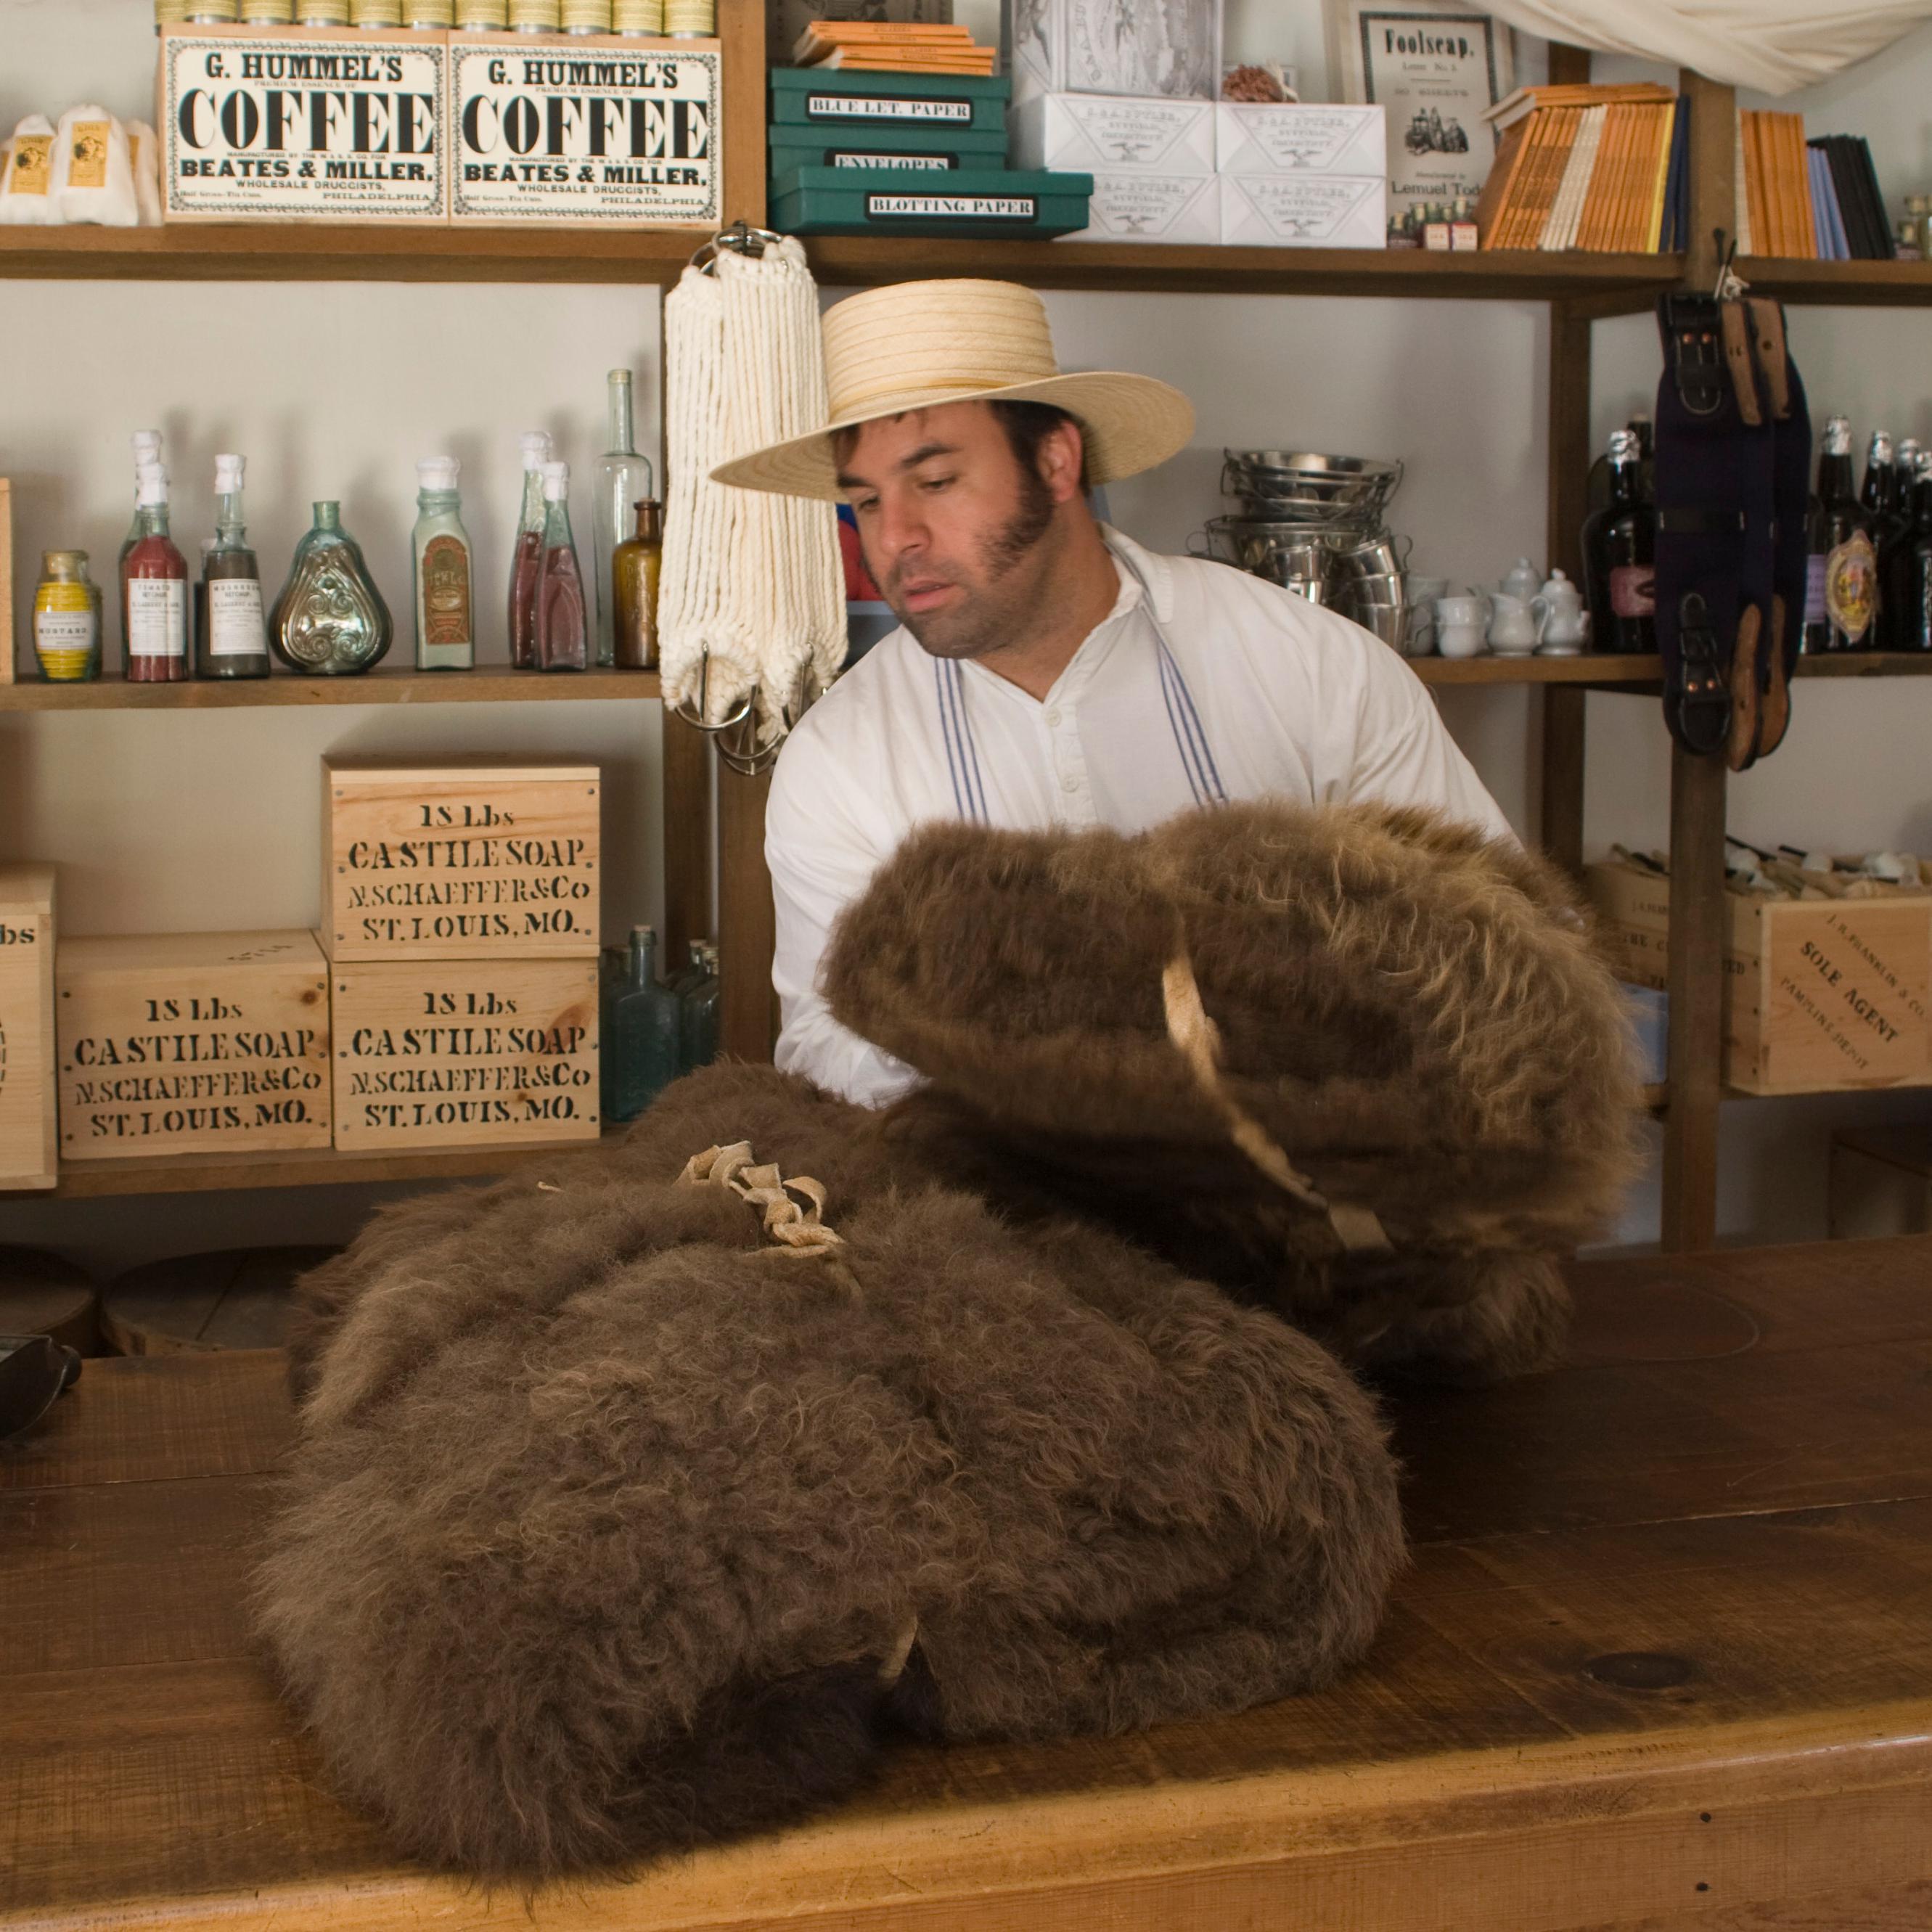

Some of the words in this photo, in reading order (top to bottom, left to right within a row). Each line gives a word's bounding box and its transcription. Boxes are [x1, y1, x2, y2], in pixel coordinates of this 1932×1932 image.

[1385, 28, 1474, 59] Foolscap.
[205, 53, 230, 78] G.
[242, 52, 403, 82] HUMMEL'S
[488, 59, 512, 85] G.
[523, 60, 678, 89] HUMMEL'S
[178, 88, 434, 154] COFFEE
[813, 99, 859, 112] BLUE
[864, 101, 903, 115] LET.
[912, 102, 967, 118] PAPER
[462, 94, 708, 160] COFFEE
[181, 159, 290, 177] BEATES
[298, 160, 316, 178] &
[326, 160, 433, 181] MILLER,
[464, 163, 569, 181] BEATES
[577, 165, 595, 182] &
[604, 165, 707, 186] MILLER,
[237, 180, 308, 189] WHOLESALE
[314, 181, 386, 191] DRUGGISTS,
[517, 184, 587, 193] WHOLESALE
[594, 186, 662, 196] DRUGGISTS,
[1392, 180, 1447, 195] Lemuel
[873, 198, 965, 213] BLOTTING
[973, 200, 1031, 215] PAPER
[419, 805, 453, 827] 18
[462, 805, 515, 827] Lbs
[348, 840, 499, 869] CASTILE
[506, 839, 584, 867] SOAP
[424, 992, 456, 1015] 18
[466, 992, 517, 1015] Lbs
[1801, 941, 1843, 988] SOLE
[1844, 988, 1899, 1044] AGENT
[146, 999, 180, 1022] 18
[189, 997, 243, 1020] Lbs
[75, 1033, 229, 1066] CASTILE
[234, 1030, 315, 1059] SOAP
[353, 1028, 502, 1056] CASTILE
[508, 1026, 586, 1055] SOAP
